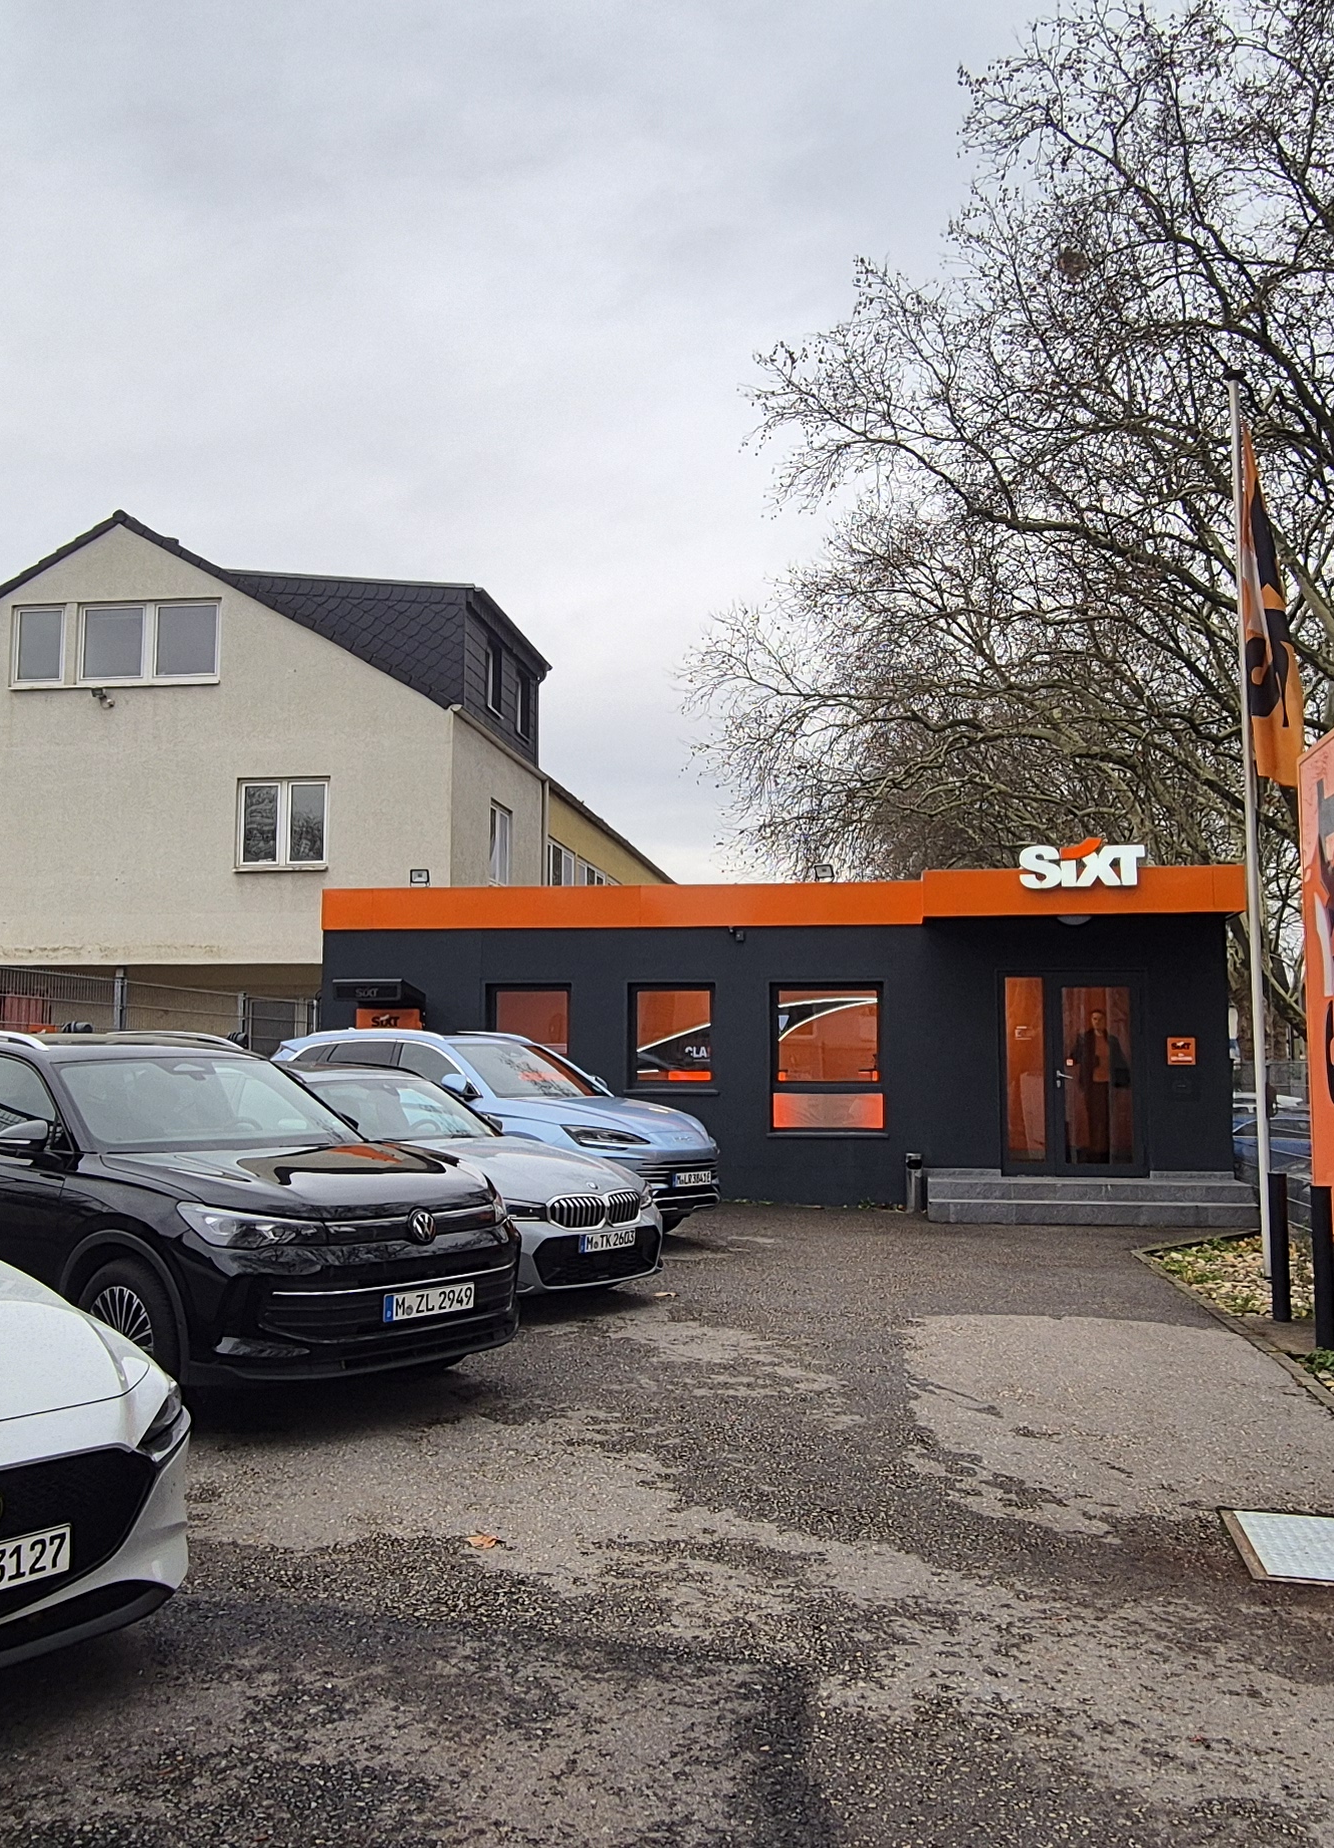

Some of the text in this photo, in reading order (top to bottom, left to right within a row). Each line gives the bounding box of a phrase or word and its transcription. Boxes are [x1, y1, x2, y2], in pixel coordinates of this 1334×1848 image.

[1018, 837, 1145, 889] SIXT
[371, 1014, 401, 1028] SIXT
[395, 1296, 406, 1317] M
[415, 1293, 435, 1313] ZL
[438, 1286, 473, 1310] 2949
